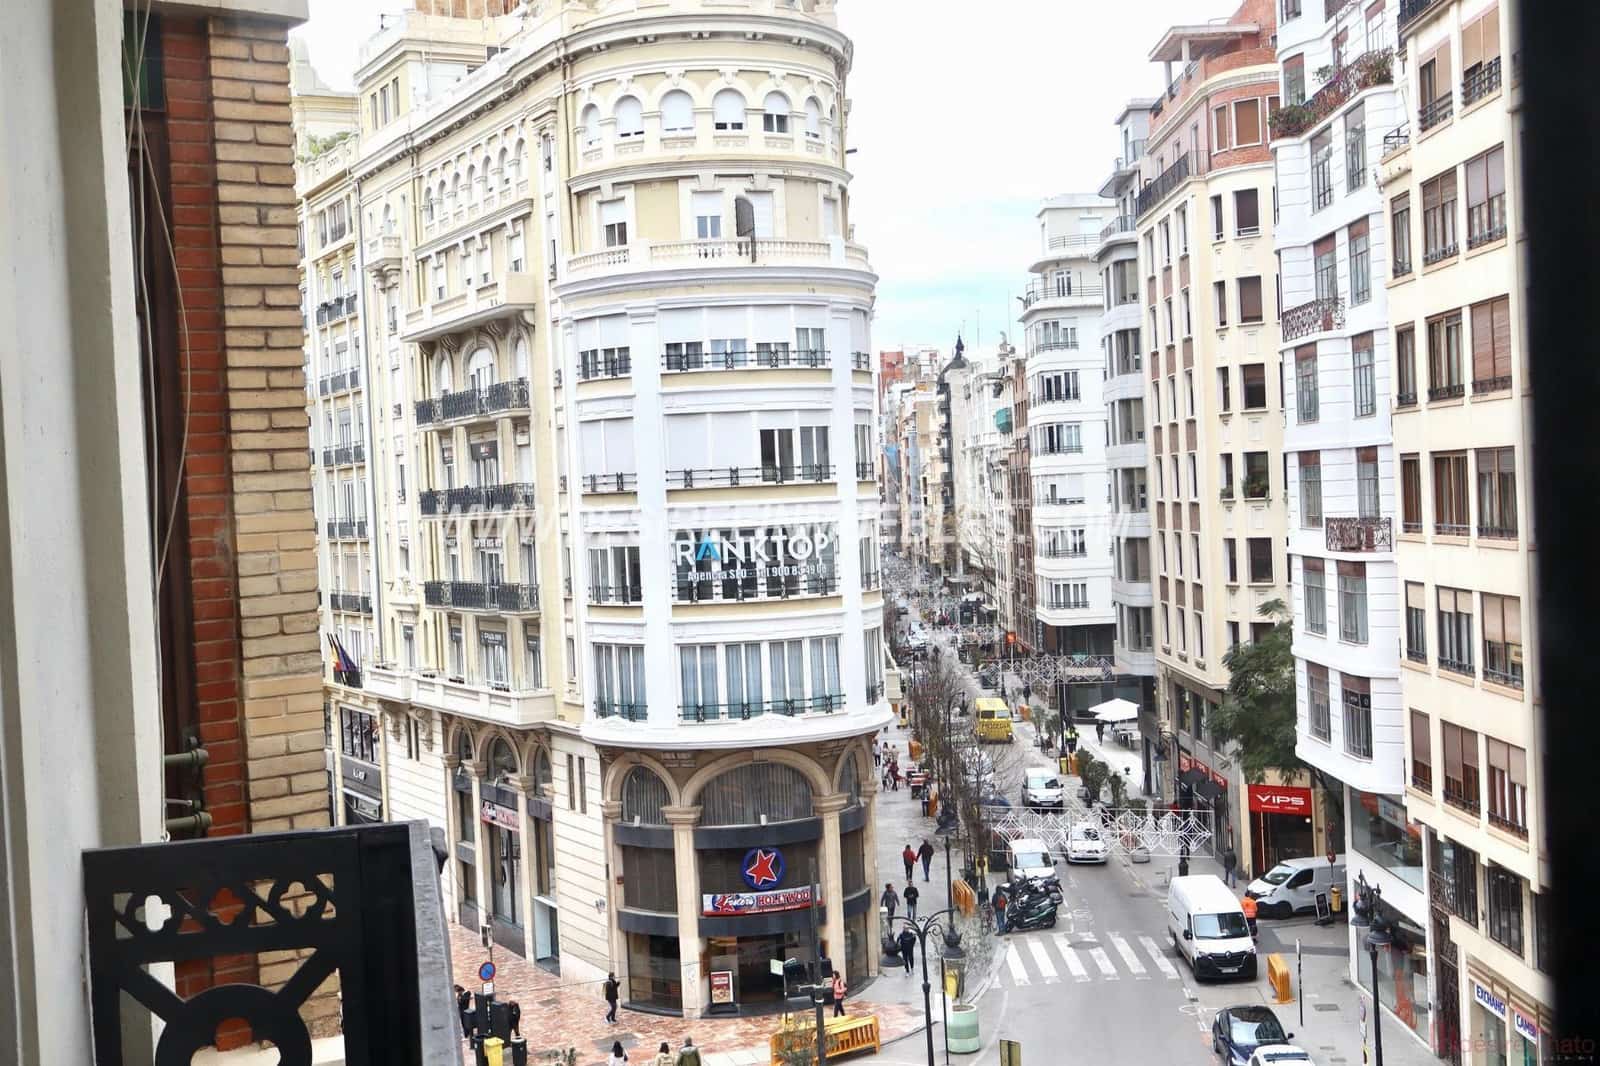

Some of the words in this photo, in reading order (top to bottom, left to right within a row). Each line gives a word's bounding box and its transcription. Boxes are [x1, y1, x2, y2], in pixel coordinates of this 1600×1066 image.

[675, 533, 829, 566] RANKTOP
[687, 569, 728, 582] Agencia
[771, 566, 790, 577] 900
[1256, 793, 1305, 806] VIPS
